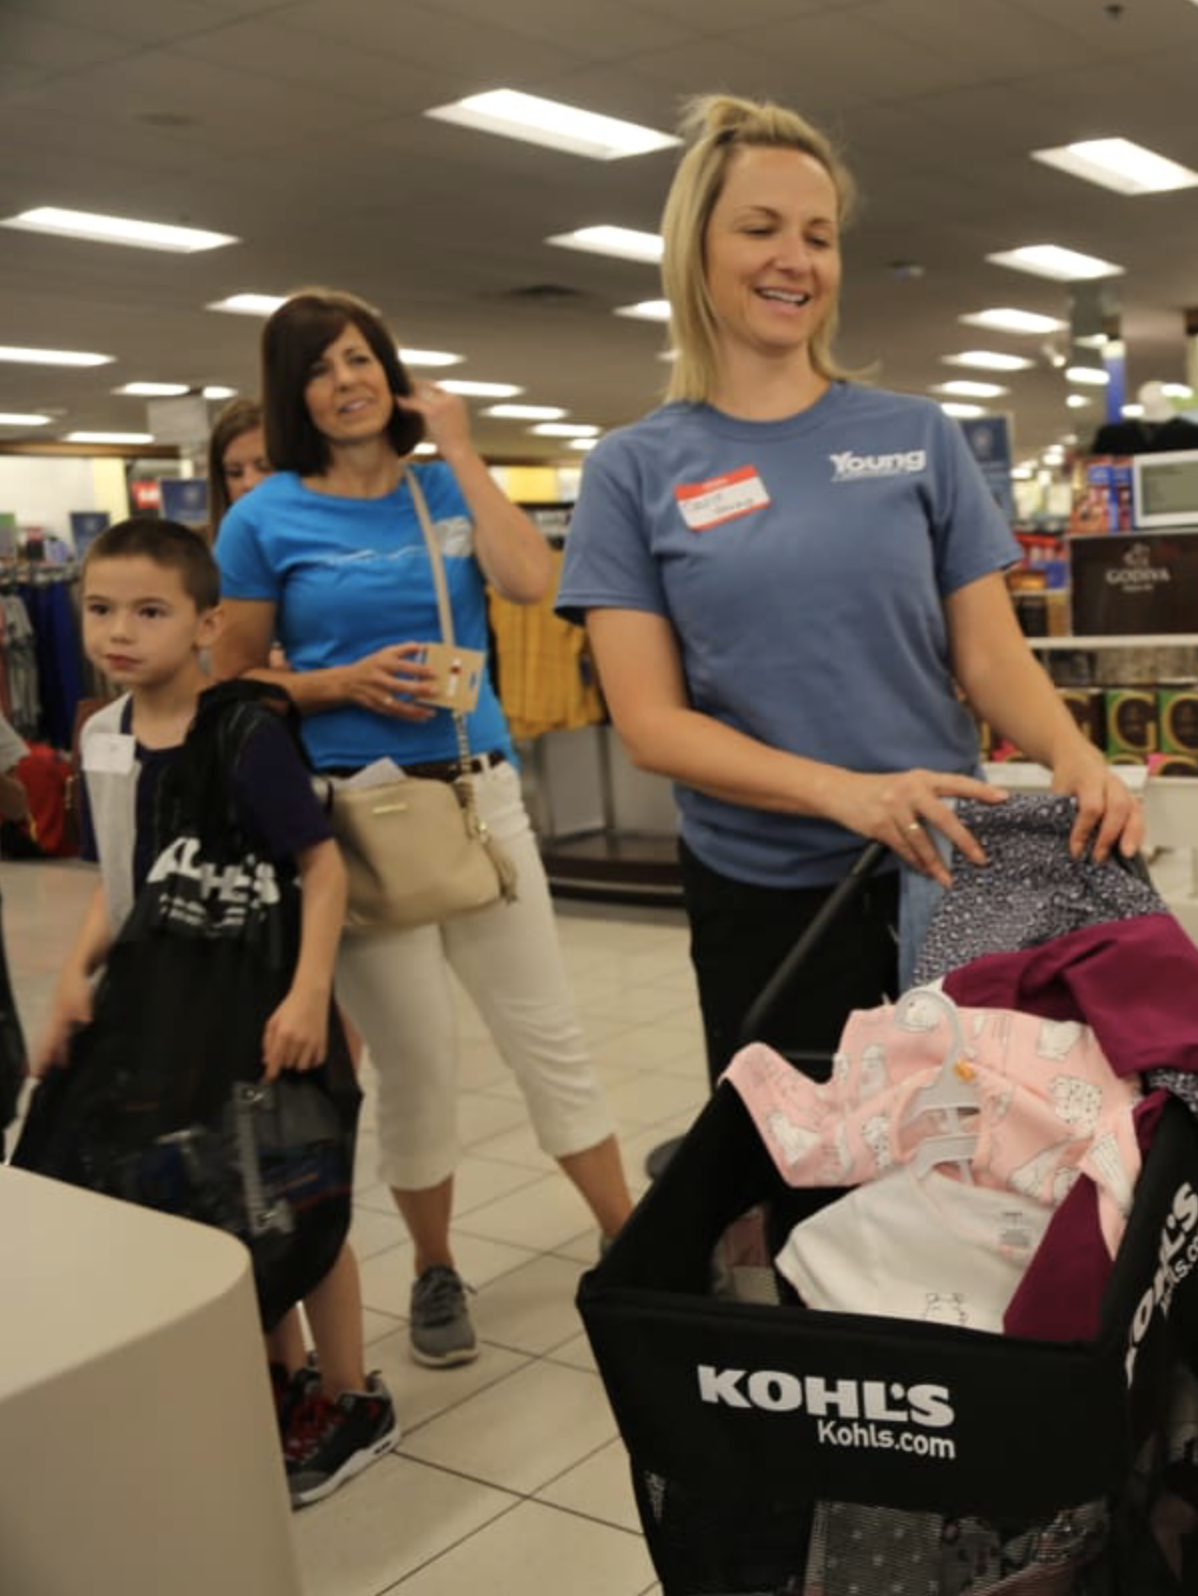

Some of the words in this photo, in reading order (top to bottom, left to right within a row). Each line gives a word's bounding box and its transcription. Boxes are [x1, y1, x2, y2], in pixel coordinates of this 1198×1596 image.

[829, 450, 926, 474] Young
[698, 1365, 954, 1428] KOHL'S
[818, 1420, 955, 1459] Kohls.com
